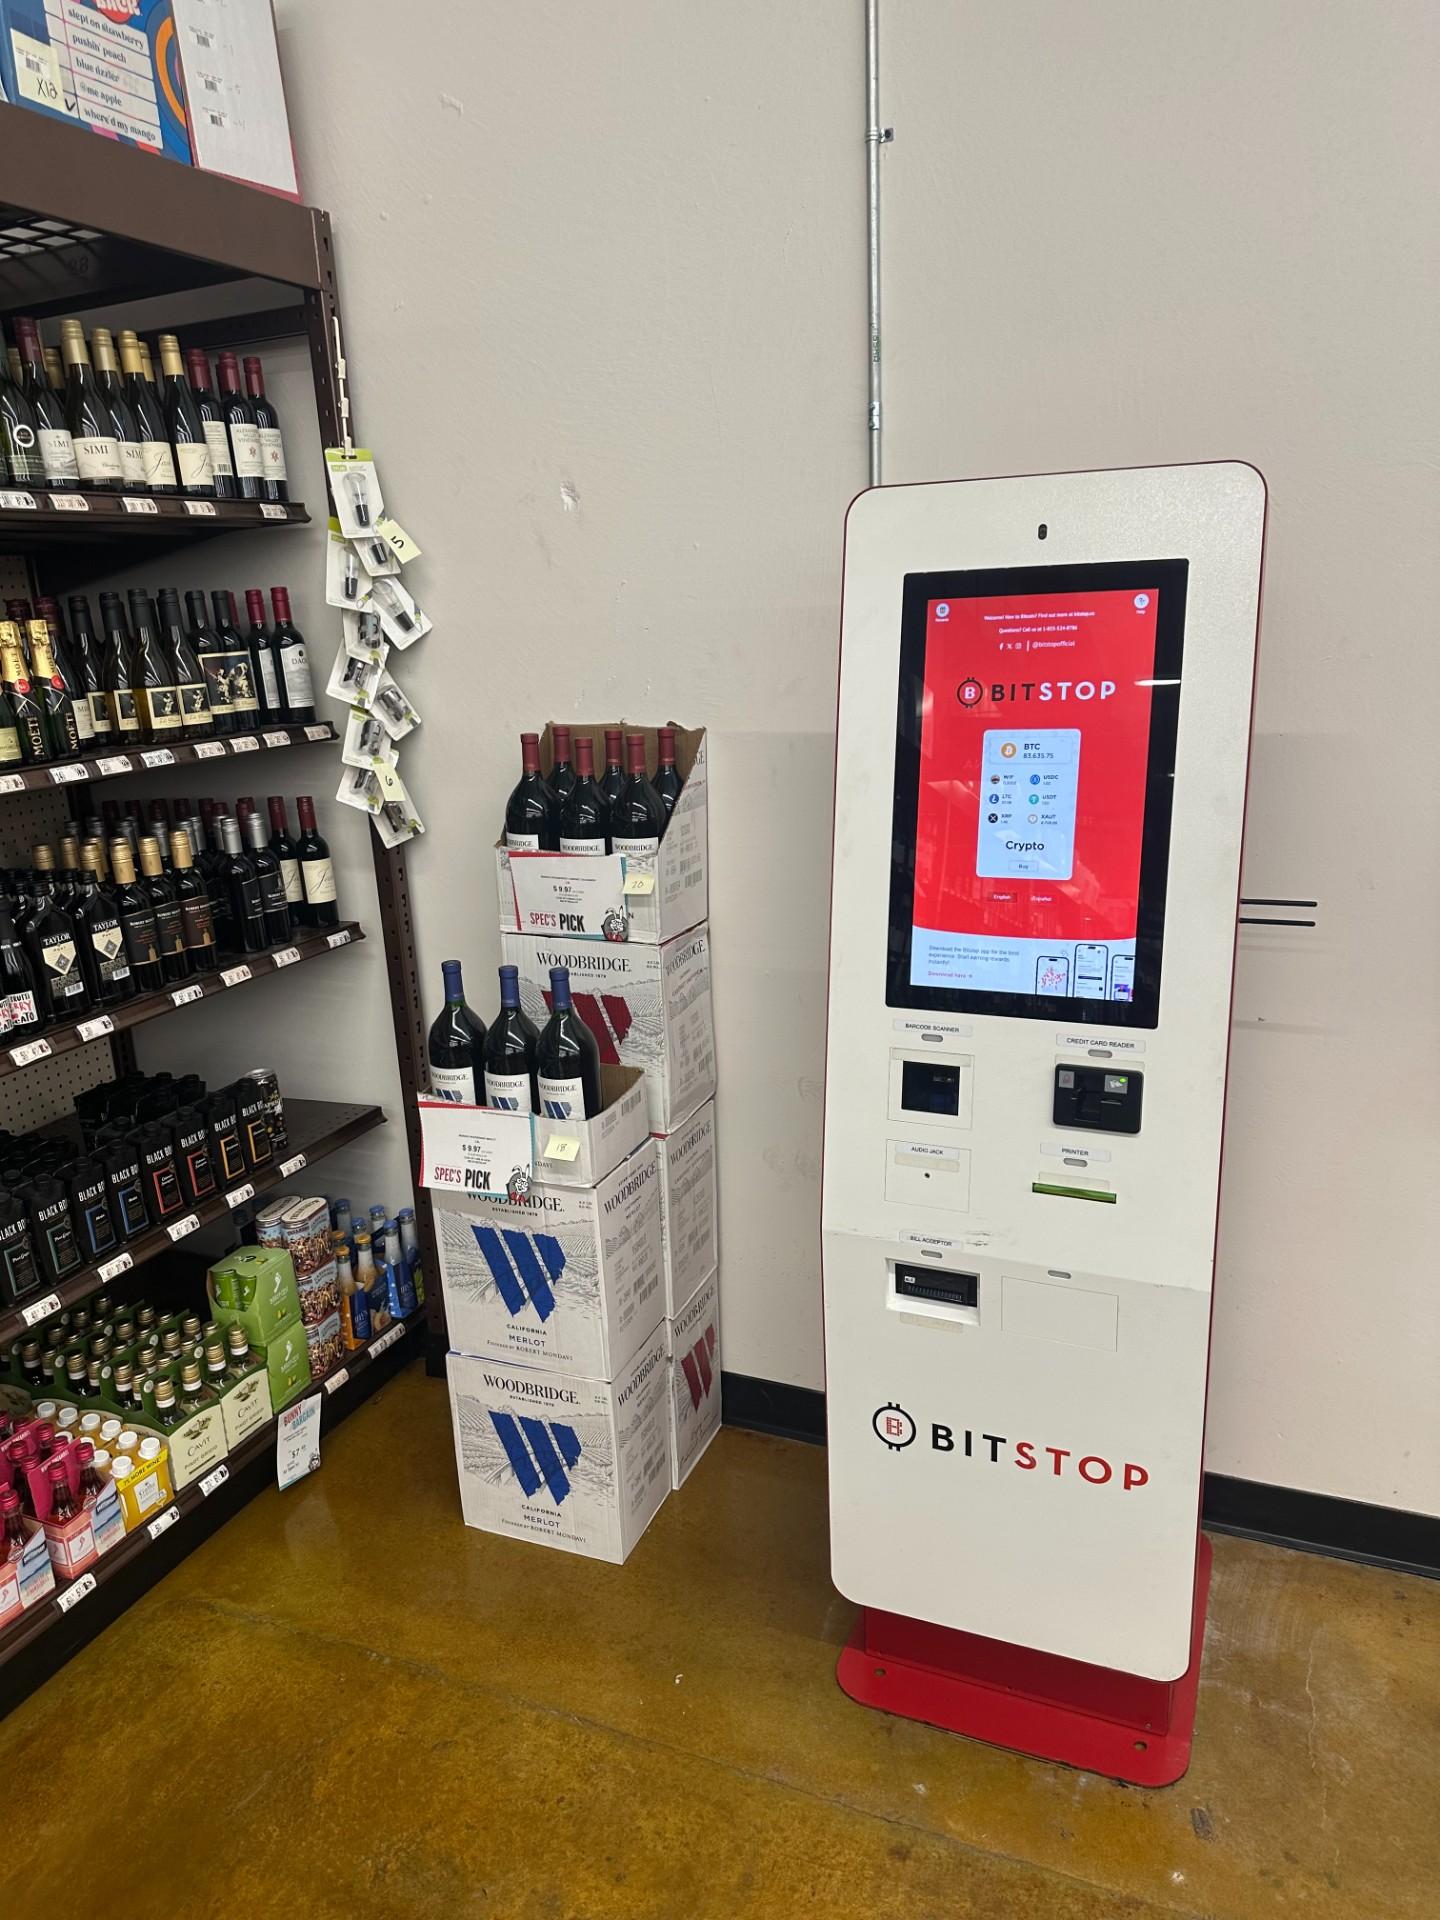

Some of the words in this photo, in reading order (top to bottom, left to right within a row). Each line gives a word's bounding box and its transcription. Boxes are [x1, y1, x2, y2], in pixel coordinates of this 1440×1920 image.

[68, 8, 90, 25] slept
[102, 47, 127, 64] peach
[75, 56, 95, 73] blue
[101, 90, 122, 107] apple
[84, 445, 109, 455] SIMI
[126, 450, 143, 459] SIM
[390, 535, 405, 549] 5
[991, 681, 1116, 702] BITSTOP
[1024, 743, 1040, 751] BTC
[1005, 840, 1045, 852] Crypto
[631, 880, 644, 889] 20
[93, 920, 118, 931] TAYLOR
[530, 912, 557, 928] SPEC'S
[559, 913, 585, 932] PICK
[44, 933, 71, 946] TAYLOR
[536, 951, 631, 973] WOODBRIDGE
[905, 1023, 931, 1031] BARCODE
[932, 1025, 959, 1033] SCANNER
[1066, 1037, 1089, 1046] CREDIT
[1108, 1041, 1134, 1049] READER
[242, 1104, 258, 1117] BLACK
[214, 1119, 230, 1132] BLACK
[181, 1134, 199, 1148] BLACK
[911, 1146, 928, 1154] AUDIO
[1061, 1148, 1089, 1156] PRINTER
[146, 1151, 164, 1165] BLACK
[111, 1168, 130, 1184] BLACK
[434, 1166, 462, 1183] SPEC'S
[464, 1168, 491, 1190] PICK
[79, 1186, 97, 1201] BLACK
[603, 1160, 656, 1214] WOODBRIDGE
[39, 1205, 58, 1221] BLACK
[921, 1238, 952, 1247] ACCEPTOR
[506, 1323, 547, 1336] CALIFORNIA
[508, 1334, 546, 1348] MERLOT
[516, 1346, 540, 1356] ROBERT
[542, 1350, 573, 1361] MONDAVI
[618, 1343, 665, 1407] WOODBRIDGE
[483, 1374, 578, 1405] WOODBRIDGE
[283, 1404, 303, 1427] BUNNY
[292, 1407, 316, 1430] BARGAIN
[187, 1436, 211, 1457] CAVIT
[932, 1423, 1149, 1490] BITSTOP
[521, 1504, 562, 1518] CALIFORNIA
[523, 1515, 561, 1529] MERLOT
[531, 1526, 555, 1536] ROBERT
[556, 1530, 586, 1543] MONDAVI
